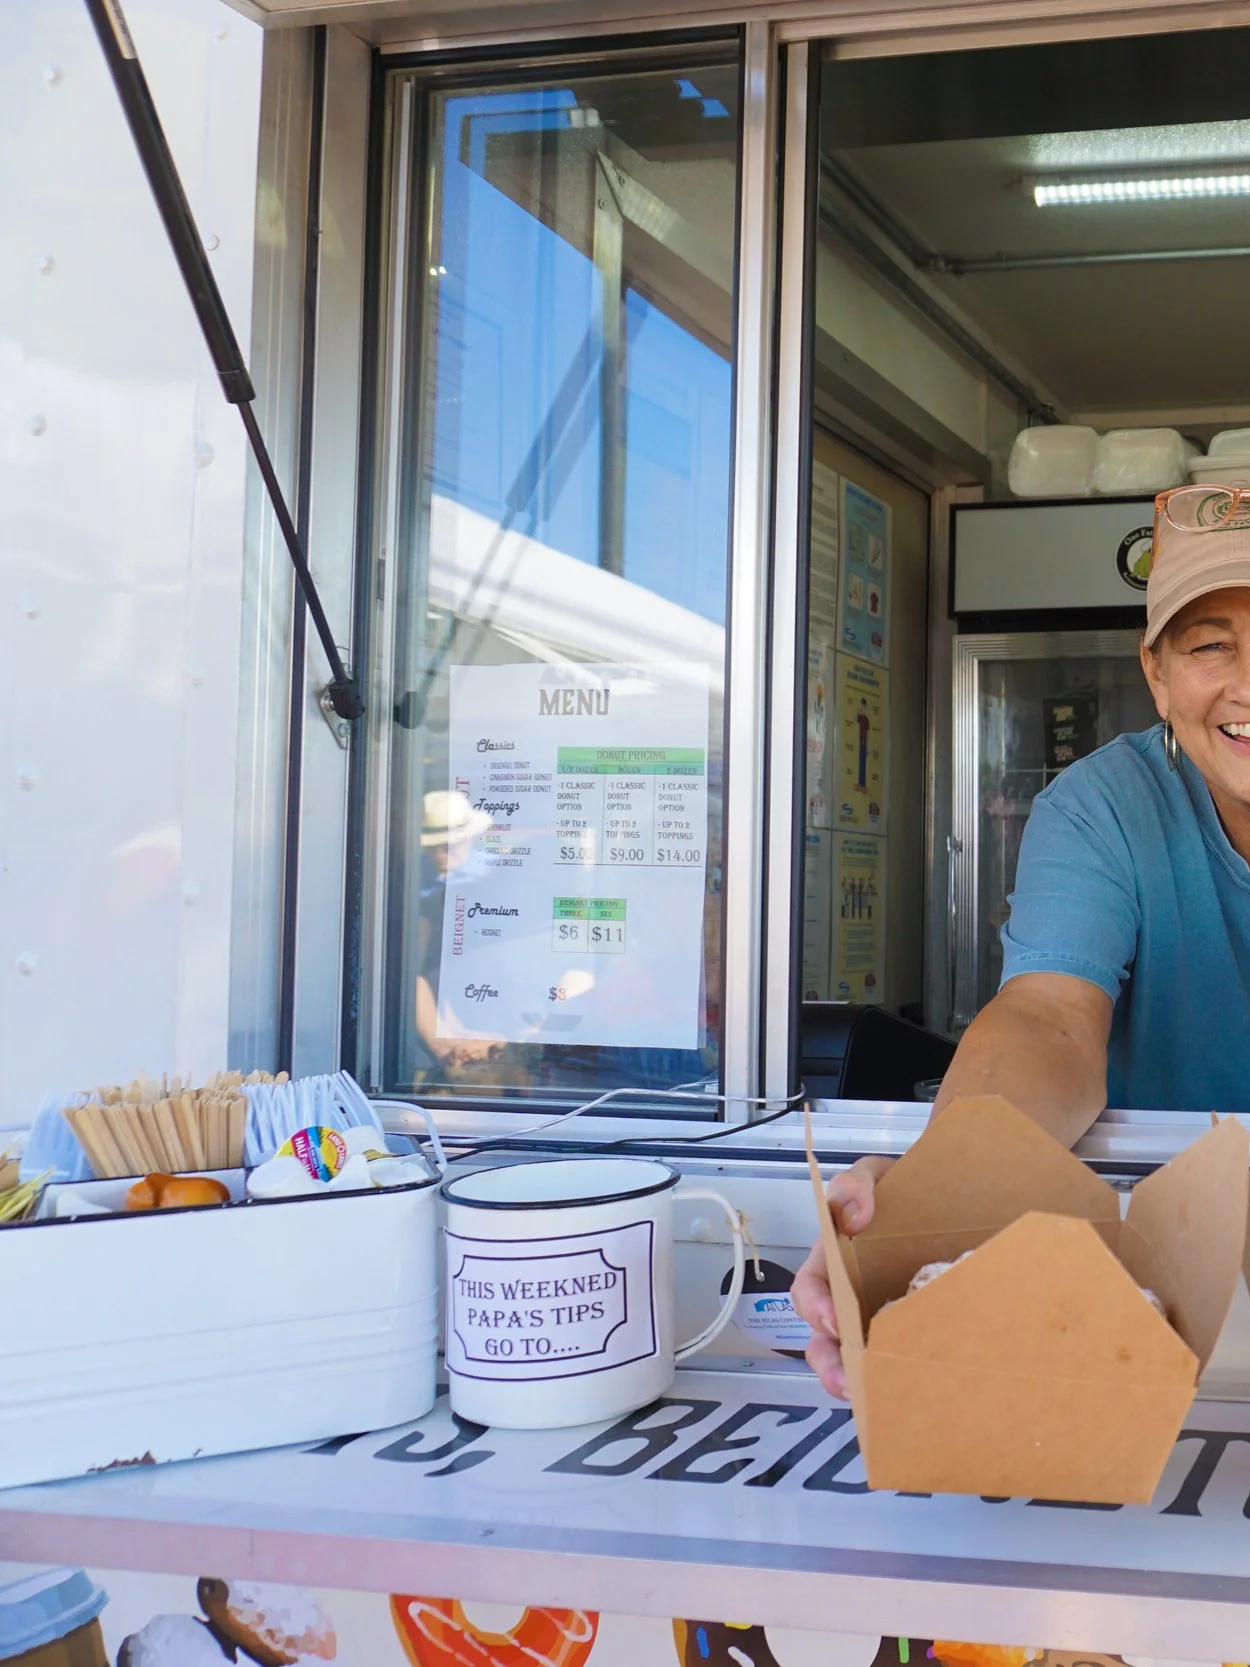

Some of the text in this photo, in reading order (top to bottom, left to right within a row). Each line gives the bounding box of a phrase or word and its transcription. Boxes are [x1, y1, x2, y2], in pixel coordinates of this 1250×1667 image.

[538, 688, 611, 715] MENU
[476, 739, 515, 752] Classics
[597, 750, 666, 760] DONUT PRICING
[473, 798, 520, 816] Toppings
[557, 803, 582, 811] OPTION
[607, 803, 632, 811] OPTION
[658, 804, 685, 812] OPTION
[560, 820, 570, 828] UP
[610, 820, 620, 828] UP
[662, 821, 673, 829] UP
[657, 832, 694, 840] TOPPINGS
[610, 847, 644, 862] $9.00
[656, 848, 701, 862] $14.00
[467, 902, 519, 917] Premium
[453, 896, 465, 956] BEIGNET
[558, 924, 579, 941] $6
[591, 926, 623, 943] $11
[465, 983, 499, 1002] Coffee
[458, 1271, 617, 1301] THIS WEEKNED
[467, 1301, 605, 1328] PAPA'S TIPS
[485, 1336, 580, 1357] GO TO....
